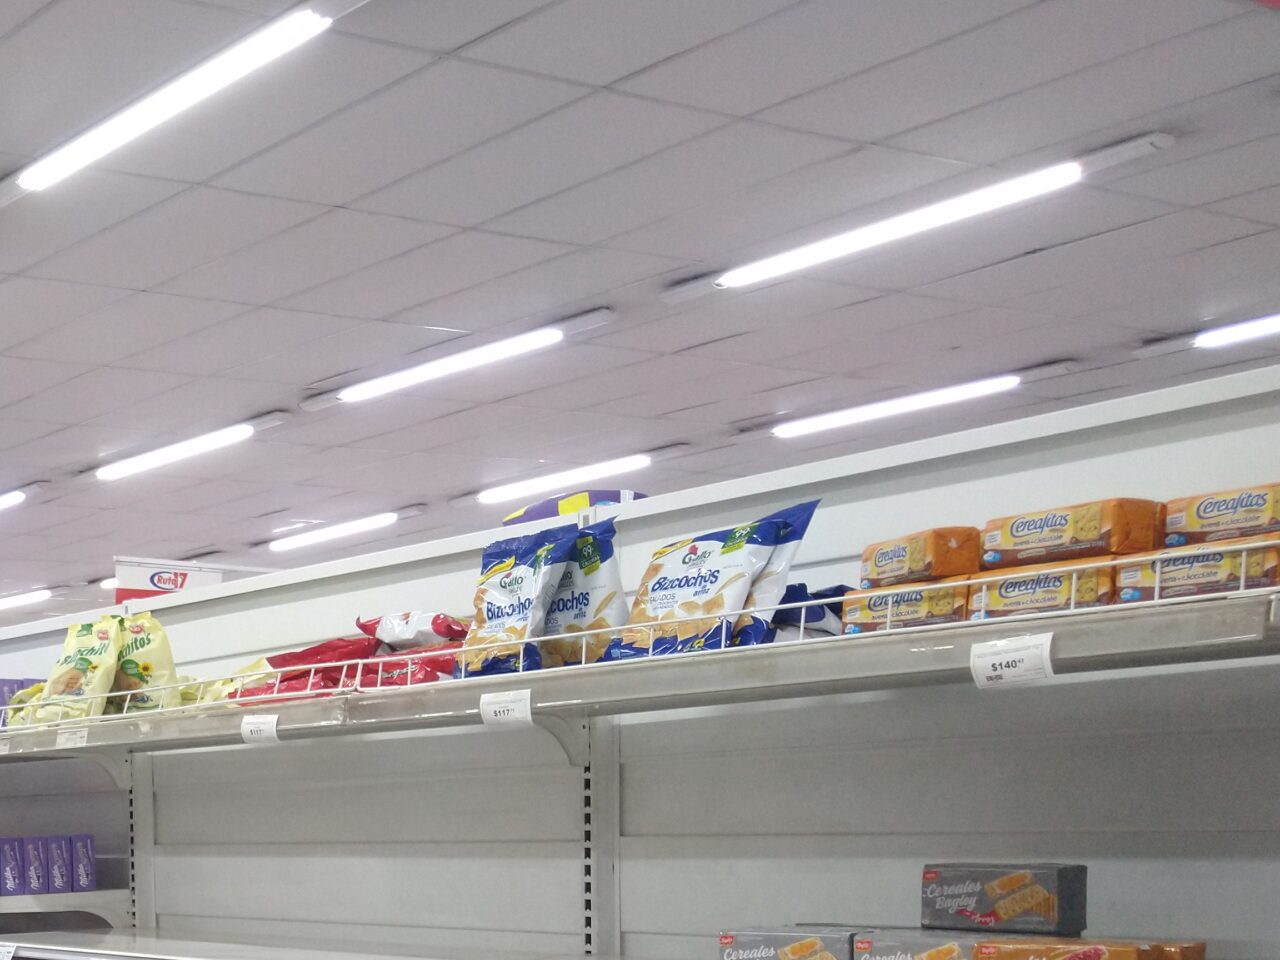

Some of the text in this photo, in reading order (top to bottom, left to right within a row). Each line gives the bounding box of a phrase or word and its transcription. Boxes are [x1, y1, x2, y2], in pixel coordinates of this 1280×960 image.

[1196, 492, 1269, 520] Cerealitas
[1010, 512, 1070, 538] Cerealitas
[650, 568, 720, 593] Bizcochos
[998, 573, 1064, 599] Cerealitas
[926, 881, 982, 897] Cereales
[935, 895, 977, 914] Bagley
[723, 946, 776, 960] Cereales
